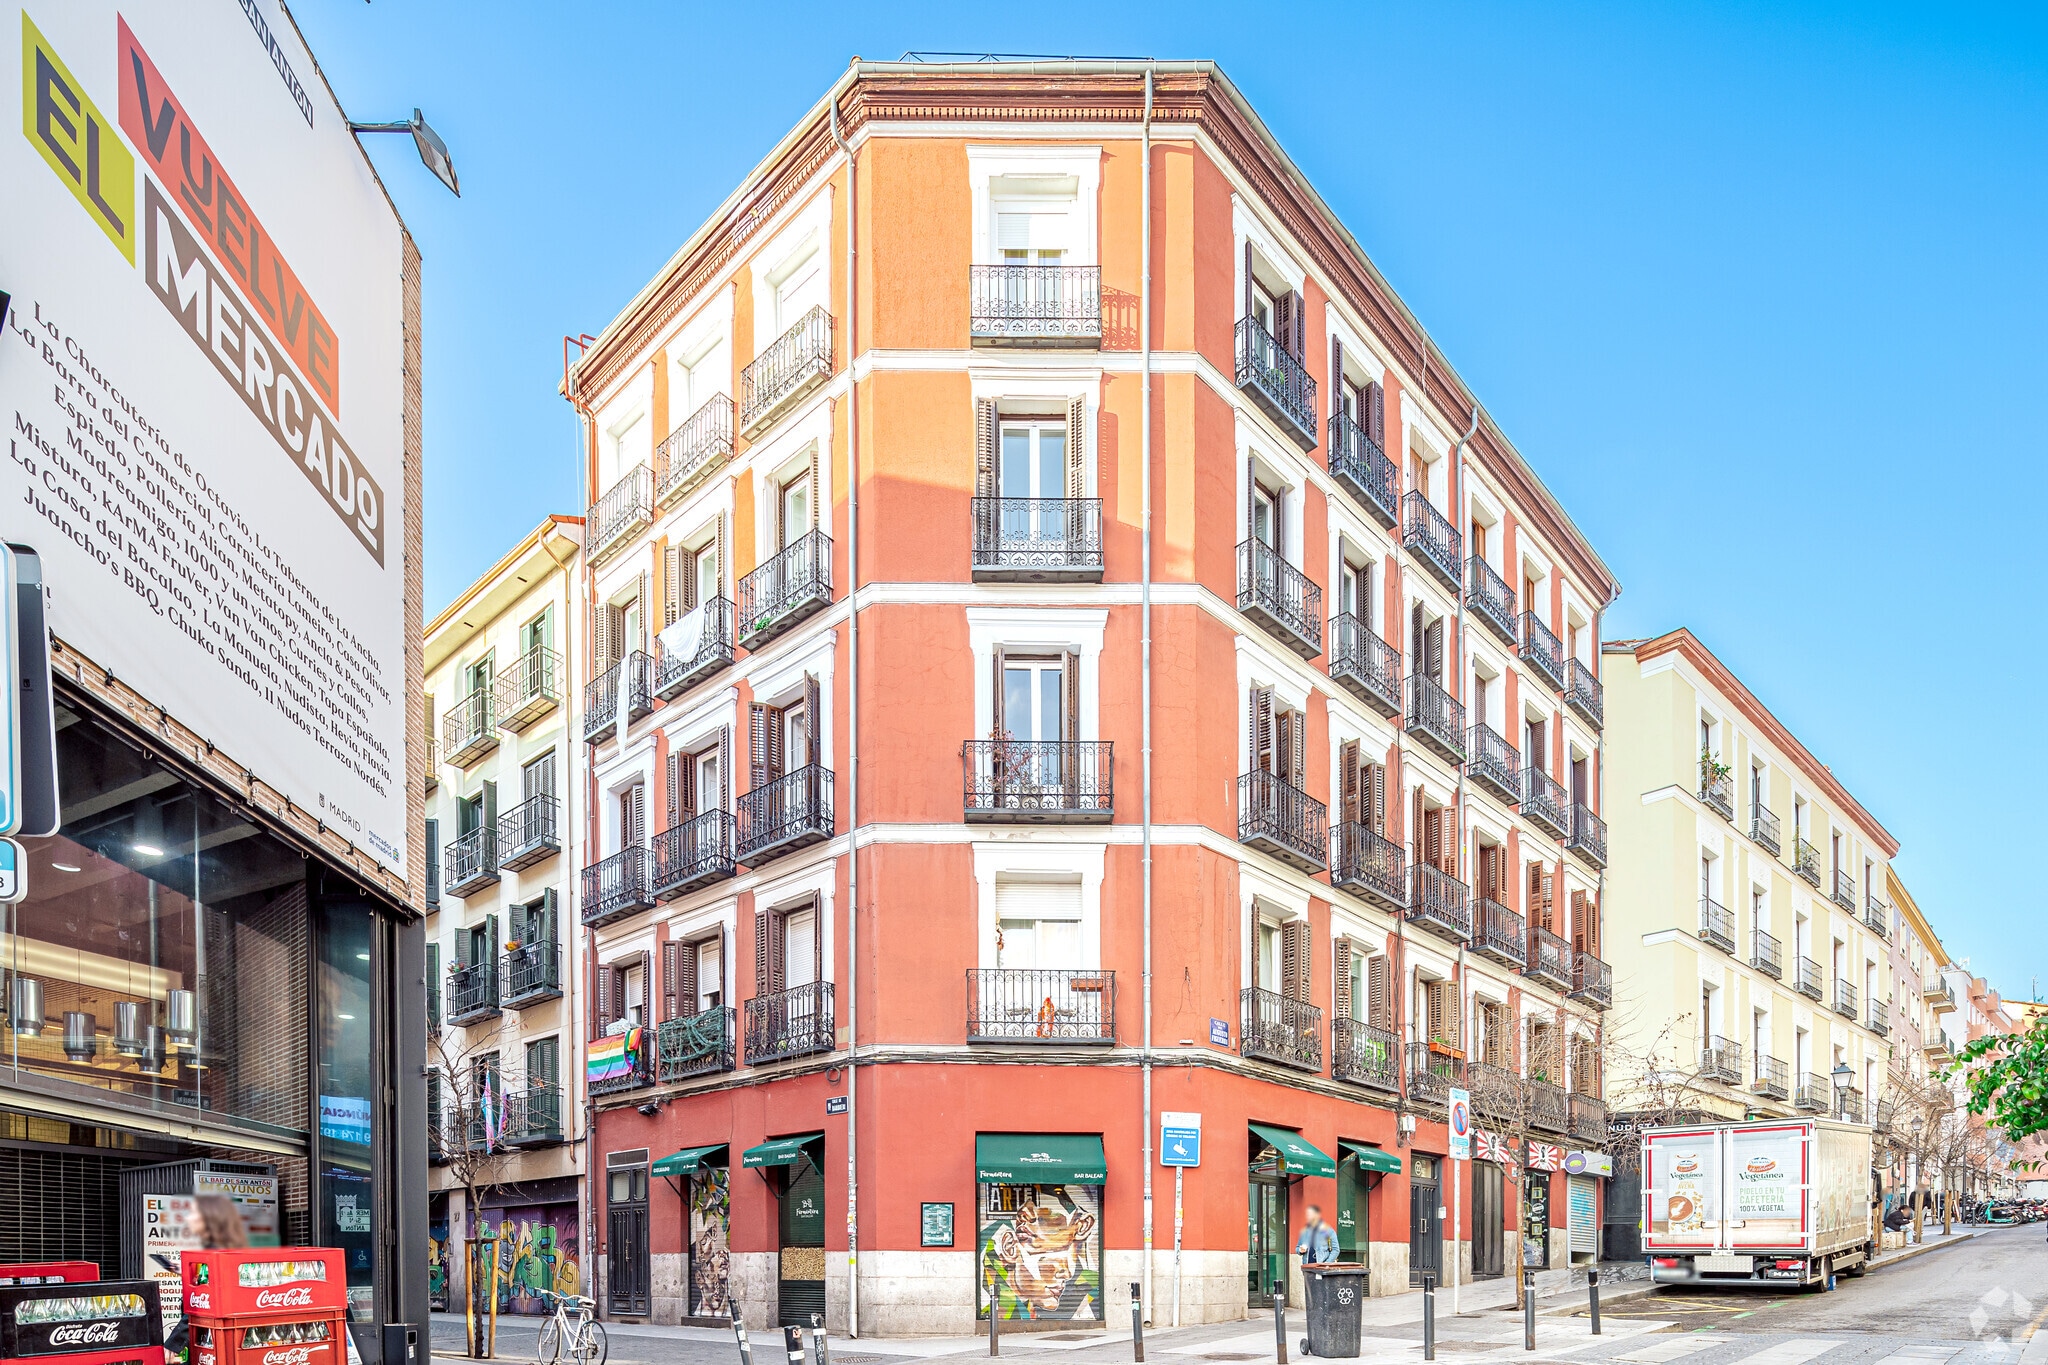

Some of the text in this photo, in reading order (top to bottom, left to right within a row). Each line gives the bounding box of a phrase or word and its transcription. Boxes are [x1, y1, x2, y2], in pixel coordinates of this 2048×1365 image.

[240, 0, 267, 46] AN
[36, 45, 124, 239] EL
[130, 46, 331, 398] VUELVE
[157, 205, 378, 552] MERCADO
[9, 307, 391, 705] La Barra del Comercial, Carnicería Lameiro, Casa Olivar,
[15, 410, 97, 501] Mistura,
[215, 592, 240, 627] Van
[243, 618, 266, 650] Van
[269, 644, 316, 697] Chicken,
[319, 687, 343, 719] Tapa
[347, 712, 389, 763] Española,
[35, 301, 381, 675] La Charcutería de Octavio, La Taberna de La Ancha,
[55, 384, 373, 707] Espiedo, Pollería Alian, Metatopy, Ancla & Pesca,
[67, 427, 368, 723] Madreamiga, 1000 y un vinos, Curries y Callos,
[10, 438, 391, 784] La Casa del Bacalao, La Manuela, Nudista, Hevia, Flavia,
[124, 567, 163, 616] BBQ,
[168, 607, 214, 654] Chuka
[218, 648, 261, 697] Sando,
[277, 696, 311, 735] Nudos
[313, 727, 351, 768] Terraza
[354, 761, 386, 798] Nordés.
[329, 802, 361, 832] MADRID
[147, 1199, 165, 1210] EL
[990, 1187, 1033, 1211] ARTE
[1758, 1204, 1785, 1212] VEGETAL
[1776, 1186, 1785, 1194] TU
[49, 1321, 121, 1346] Coca-Cola
[256, 1287, 313, 1309] Coca-Cola
